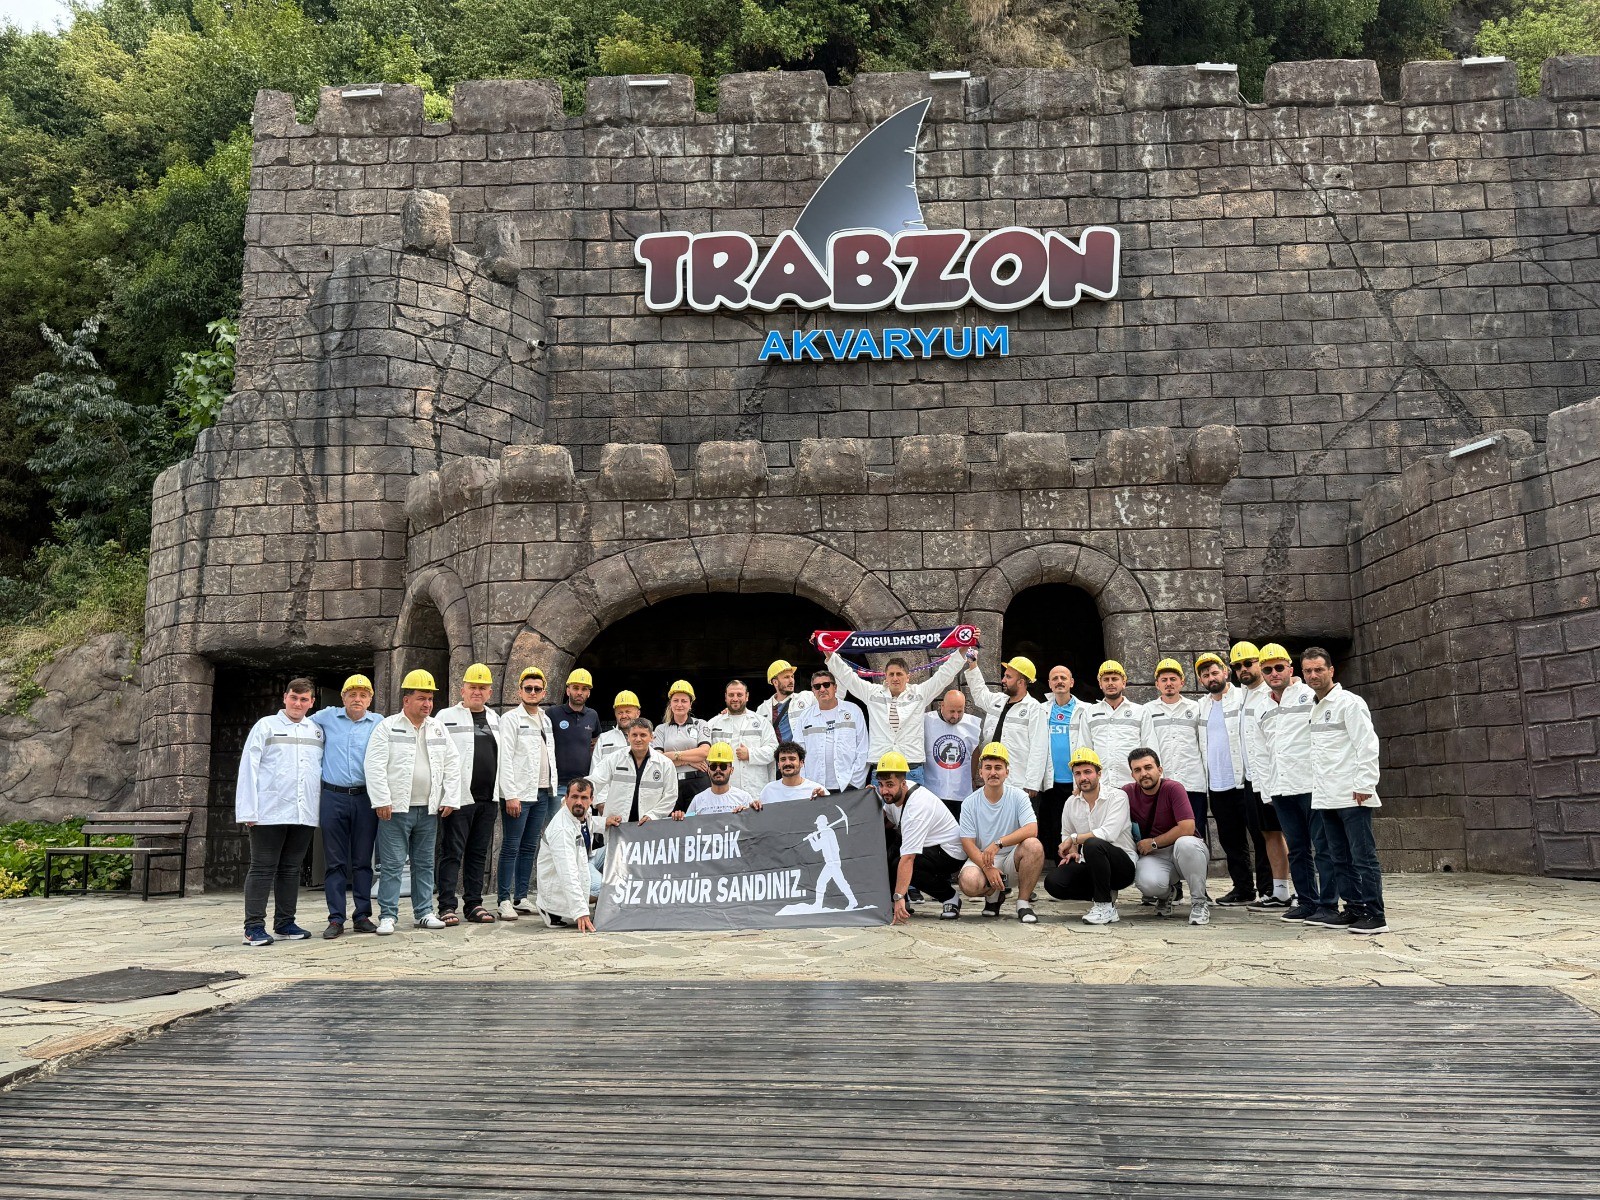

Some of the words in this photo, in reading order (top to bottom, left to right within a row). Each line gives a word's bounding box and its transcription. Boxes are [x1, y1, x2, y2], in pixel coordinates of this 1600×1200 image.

[634, 226, 1120, 312] TRABZON
[758, 326, 1009, 361] AKVARYUM
[851, 633, 941, 647] ZONGULDAKSPOR
[620, 837, 680, 865] YANAN
[684, 826, 741, 863] BİZDİK
[611, 874, 643, 905] SİZ
[646, 872, 712, 904] KÖMÜR
[716, 869, 807, 903] SANDINIZ.
